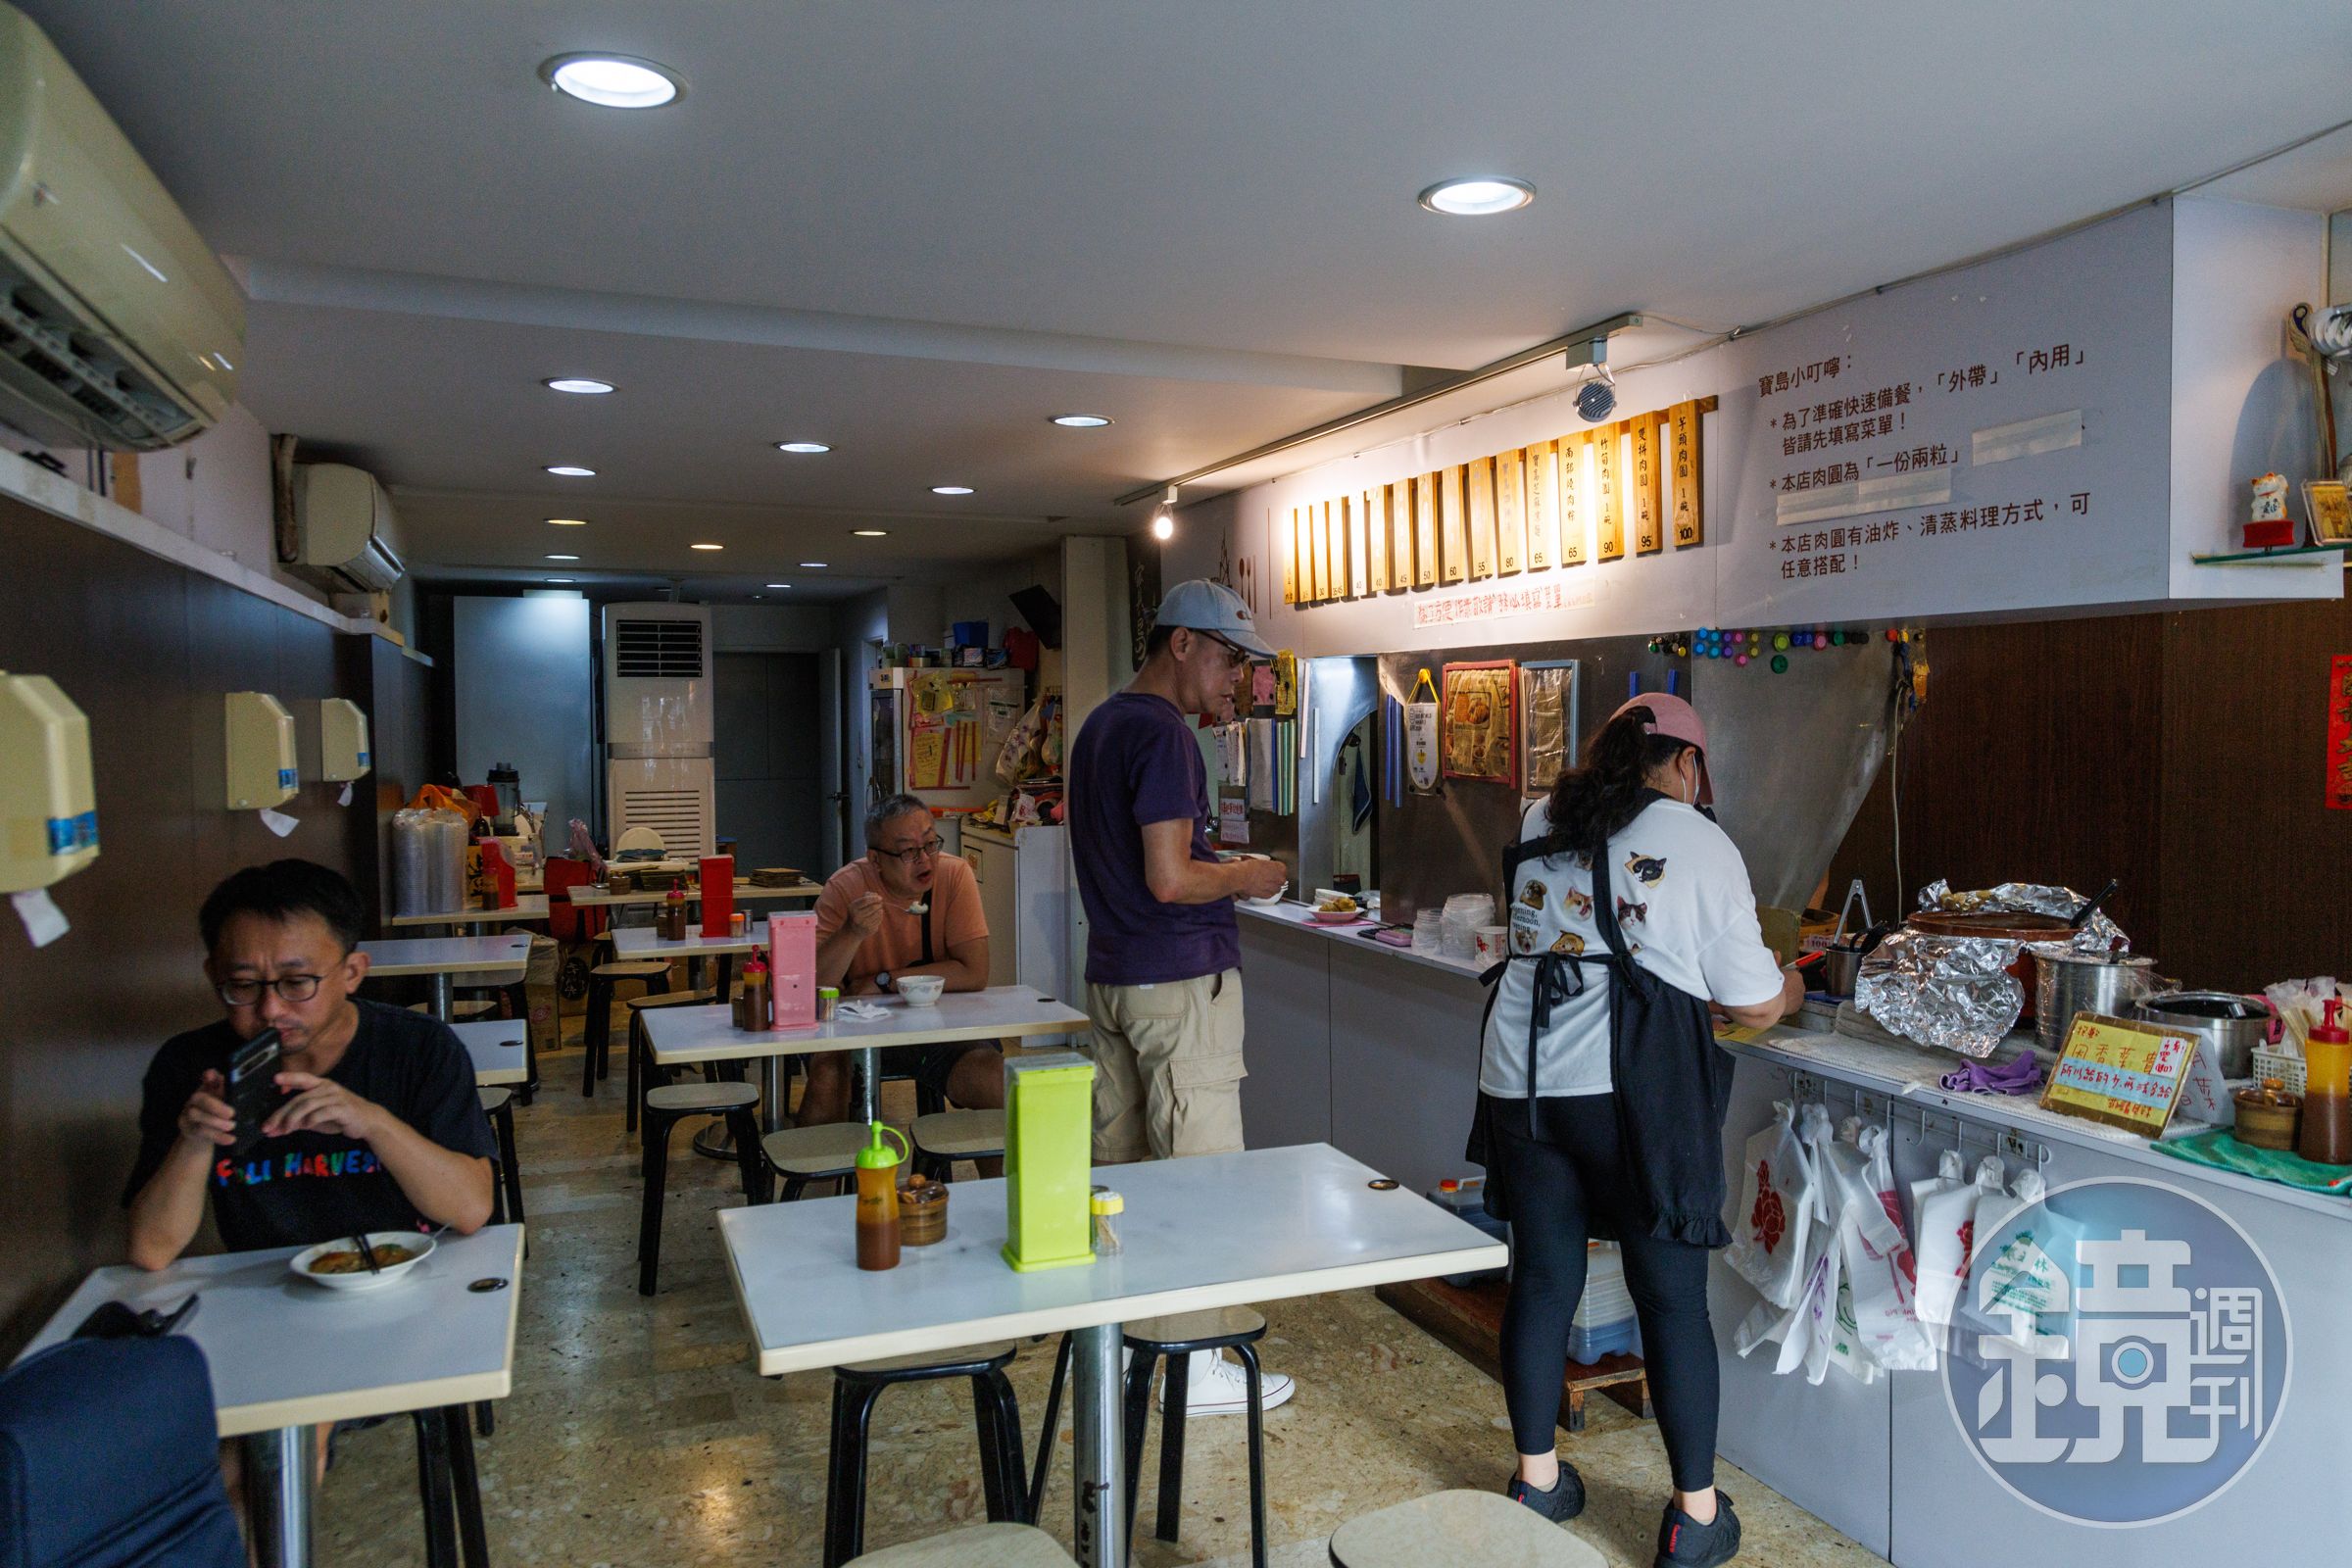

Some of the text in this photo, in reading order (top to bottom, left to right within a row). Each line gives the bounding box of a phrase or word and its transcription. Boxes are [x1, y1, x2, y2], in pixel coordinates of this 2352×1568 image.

[1783, 412, 1906, 457] 皆請先填寫菜單！
[1678, 416, 1689, 478] 芋頭肉圓
[1679, 526, 1692, 540] 100
[1603, 541, 1613, 553] 90
[1641, 535, 1652, 547] 95
[1535, 553, 1544, 564] 65
[1568, 547, 1577, 558] 65
[1478, 562, 1486, 572] 55
[1505, 557, 1514, 567] 80
[1781, 554, 1859, 579] 任意搭配！
[1423, 570, 1431, 580] 50
[1449, 566, 1457, 576] 60
[284, 1150, 381, 1178] HARVES
